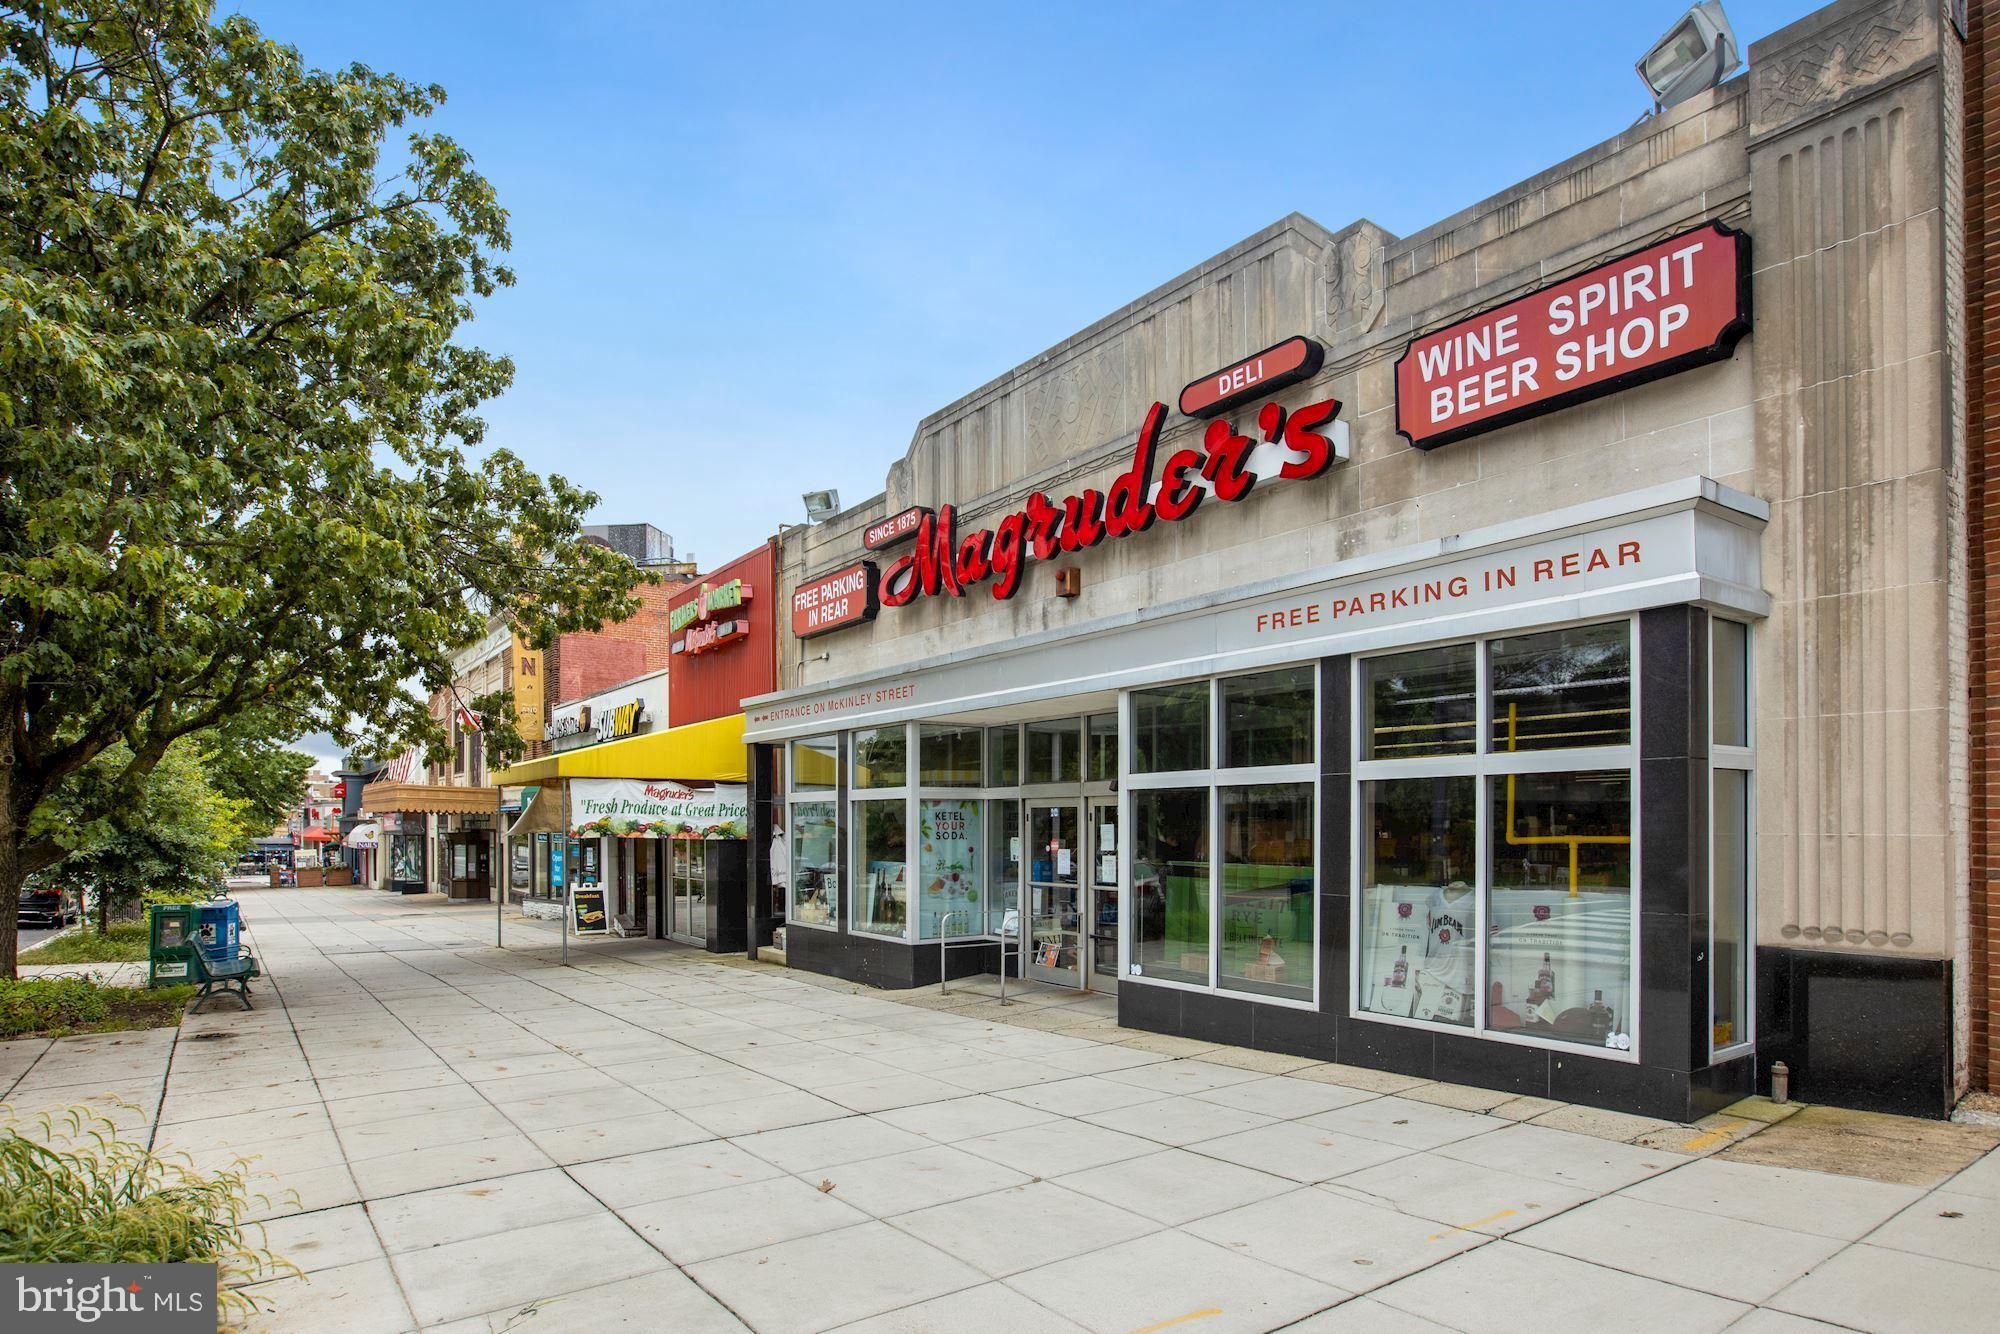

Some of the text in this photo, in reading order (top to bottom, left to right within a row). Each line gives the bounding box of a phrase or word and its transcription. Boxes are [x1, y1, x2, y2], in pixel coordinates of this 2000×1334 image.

[1417, 242, 1704, 383] WINE SPIRIT
[1218, 359, 1264, 396] DELI
[1430, 303, 1690, 424] BEER SHOP
[878, 399, 1343, 607] Magruder's
[868, 511, 917, 544] SINCE 1875
[795, 570, 864, 612] FREE PARKING
[1256, 541, 1642, 633] FREE PARKING IN REAR
[808, 598, 849, 627] IN REAR
[596, 697, 641, 741] SUBWAY
[770, 684, 916, 721] ENTRANCE ON McKINLEY STREET
[581, 798, 748, 818] "Fresh Produce at Great Price
[644, 784, 694, 800] Magruder's
[935, 811, 965, 820] KETEL
[935, 822, 965, 830] YOUR
[935, 831, 968, 840] SODA.
